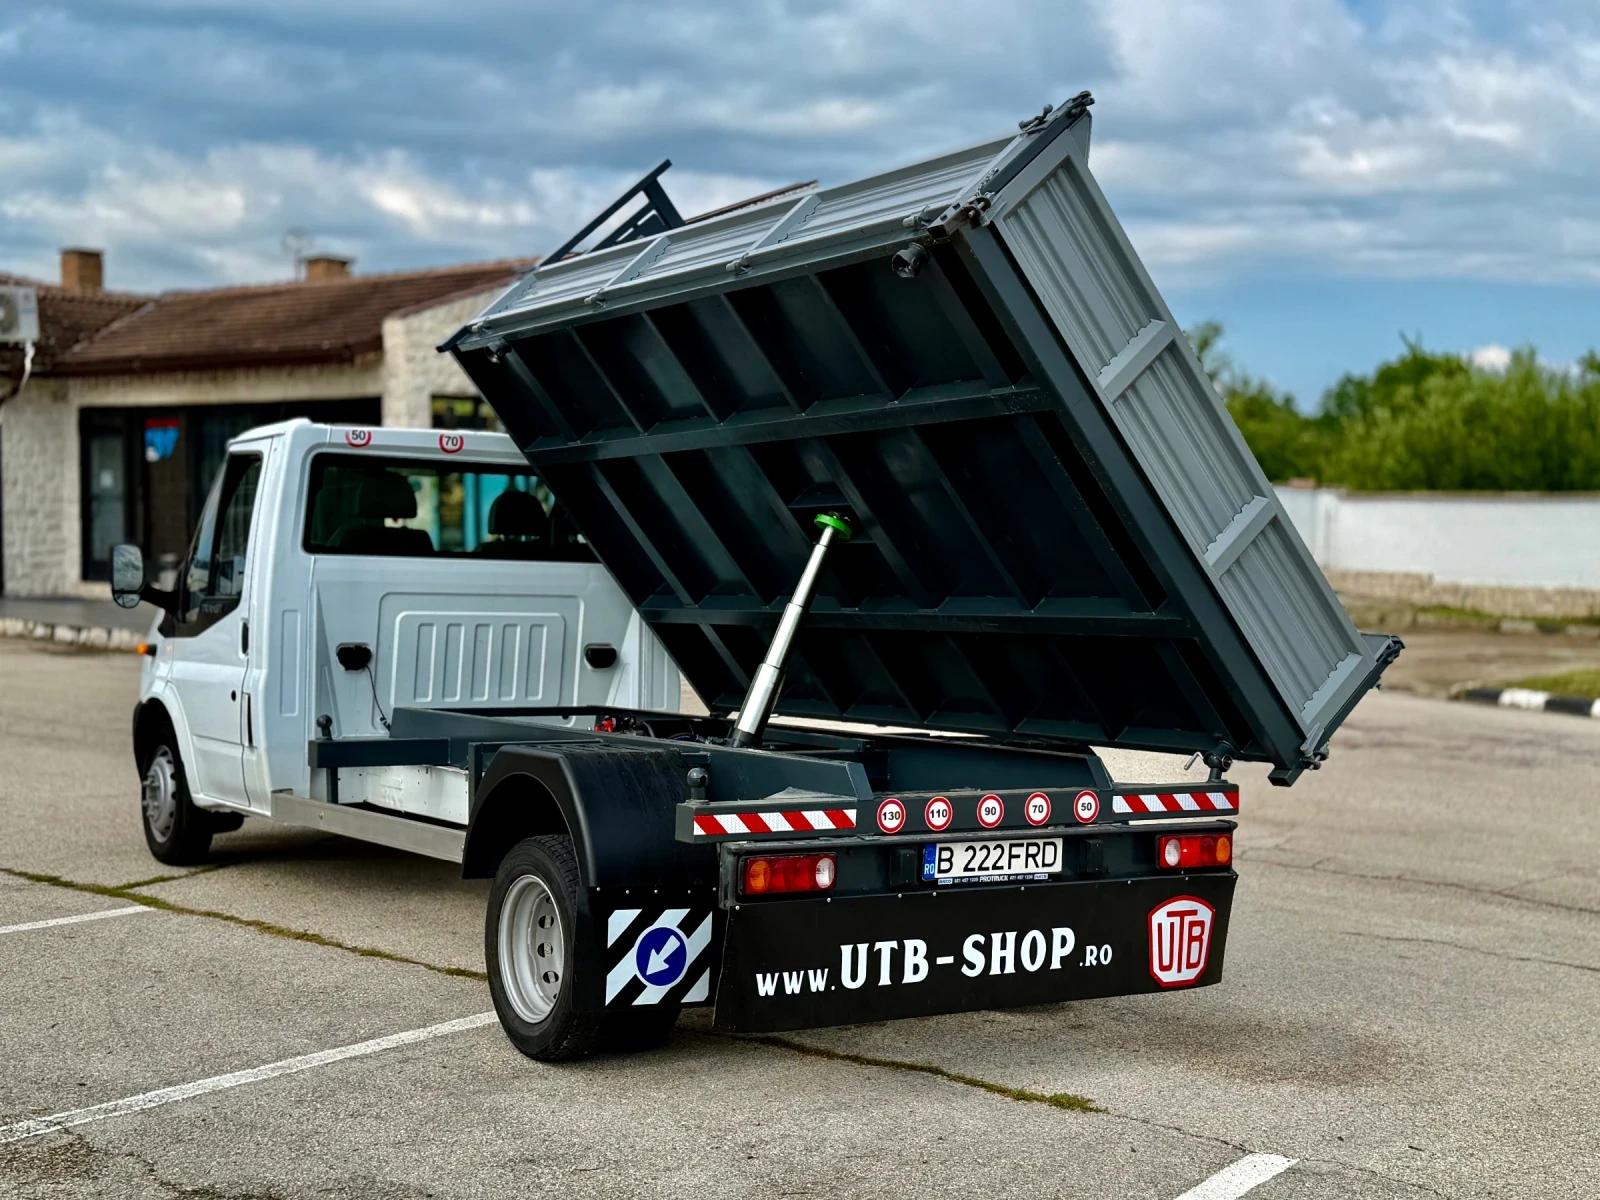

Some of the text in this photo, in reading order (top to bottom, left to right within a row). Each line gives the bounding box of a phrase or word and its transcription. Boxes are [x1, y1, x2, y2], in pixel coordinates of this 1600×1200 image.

[351, 429, 366, 441] 50
[444, 435, 459, 447] 70
[984, 806, 997, 816] 90
[1031, 804, 1044, 814] 70
[1080, 802, 1093, 812] 50
[882, 811, 901, 821] 130
[929, 808, 948, 819] 110
[924, 863, 935, 875] RO
[937, 846, 954, 874] B
[1157, 909, 1206, 974] UTB
